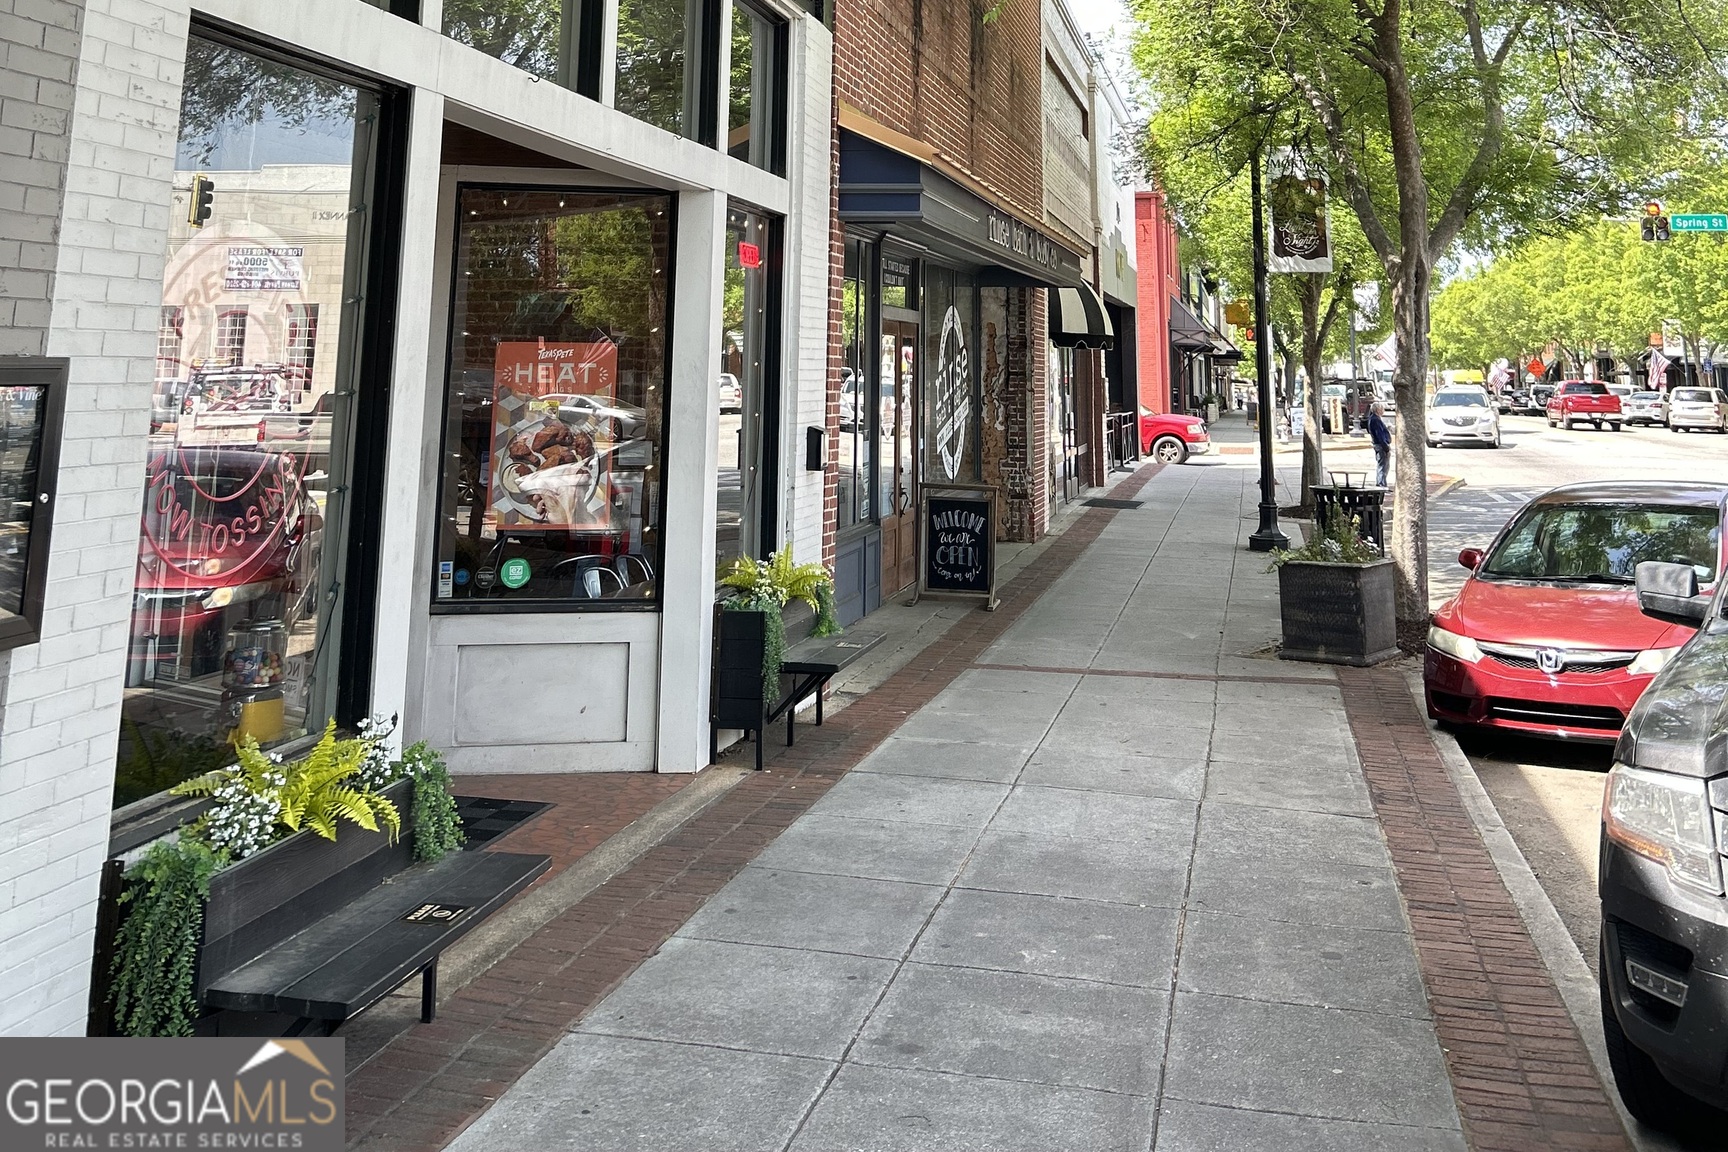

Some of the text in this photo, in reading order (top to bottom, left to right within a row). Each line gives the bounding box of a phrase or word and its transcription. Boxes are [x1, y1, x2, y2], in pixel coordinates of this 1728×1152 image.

[988, 210, 1010, 248] rinse
[1676, 218, 1723, 228] Spring St
[1283, 234, 1320, 248] Night
[515, 362, 597, 384] HEAT
[936, 348, 968, 411] rinse
[147, 449, 298, 554] NOW TOSSING
[932, 509, 986, 535] WELCOME
[936, 545, 979, 567] OPEN
[954, 572, 964, 582] on
